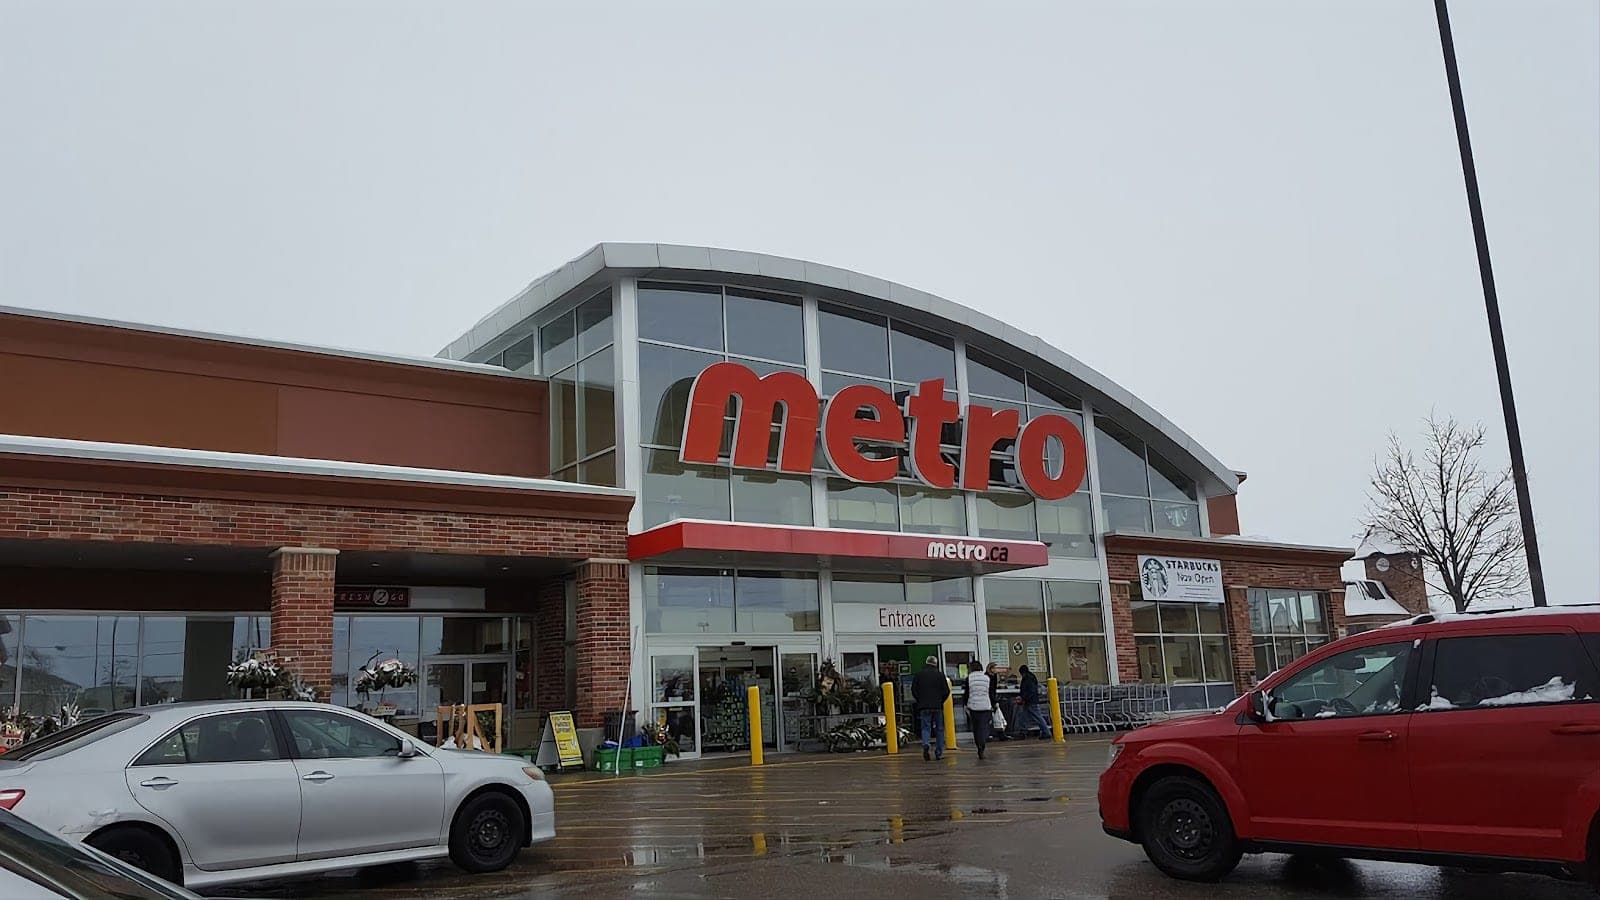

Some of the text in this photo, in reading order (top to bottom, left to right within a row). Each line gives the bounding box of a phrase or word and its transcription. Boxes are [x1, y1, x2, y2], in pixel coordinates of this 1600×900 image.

[679, 361, 1087, 501] metro
[927, 540, 1009, 562] metro.ca
[1165, 559, 1219, 572] STARBUCKS
[1177, 572, 1215, 585] Now Open
[879, 607, 936, 627] Entrance
